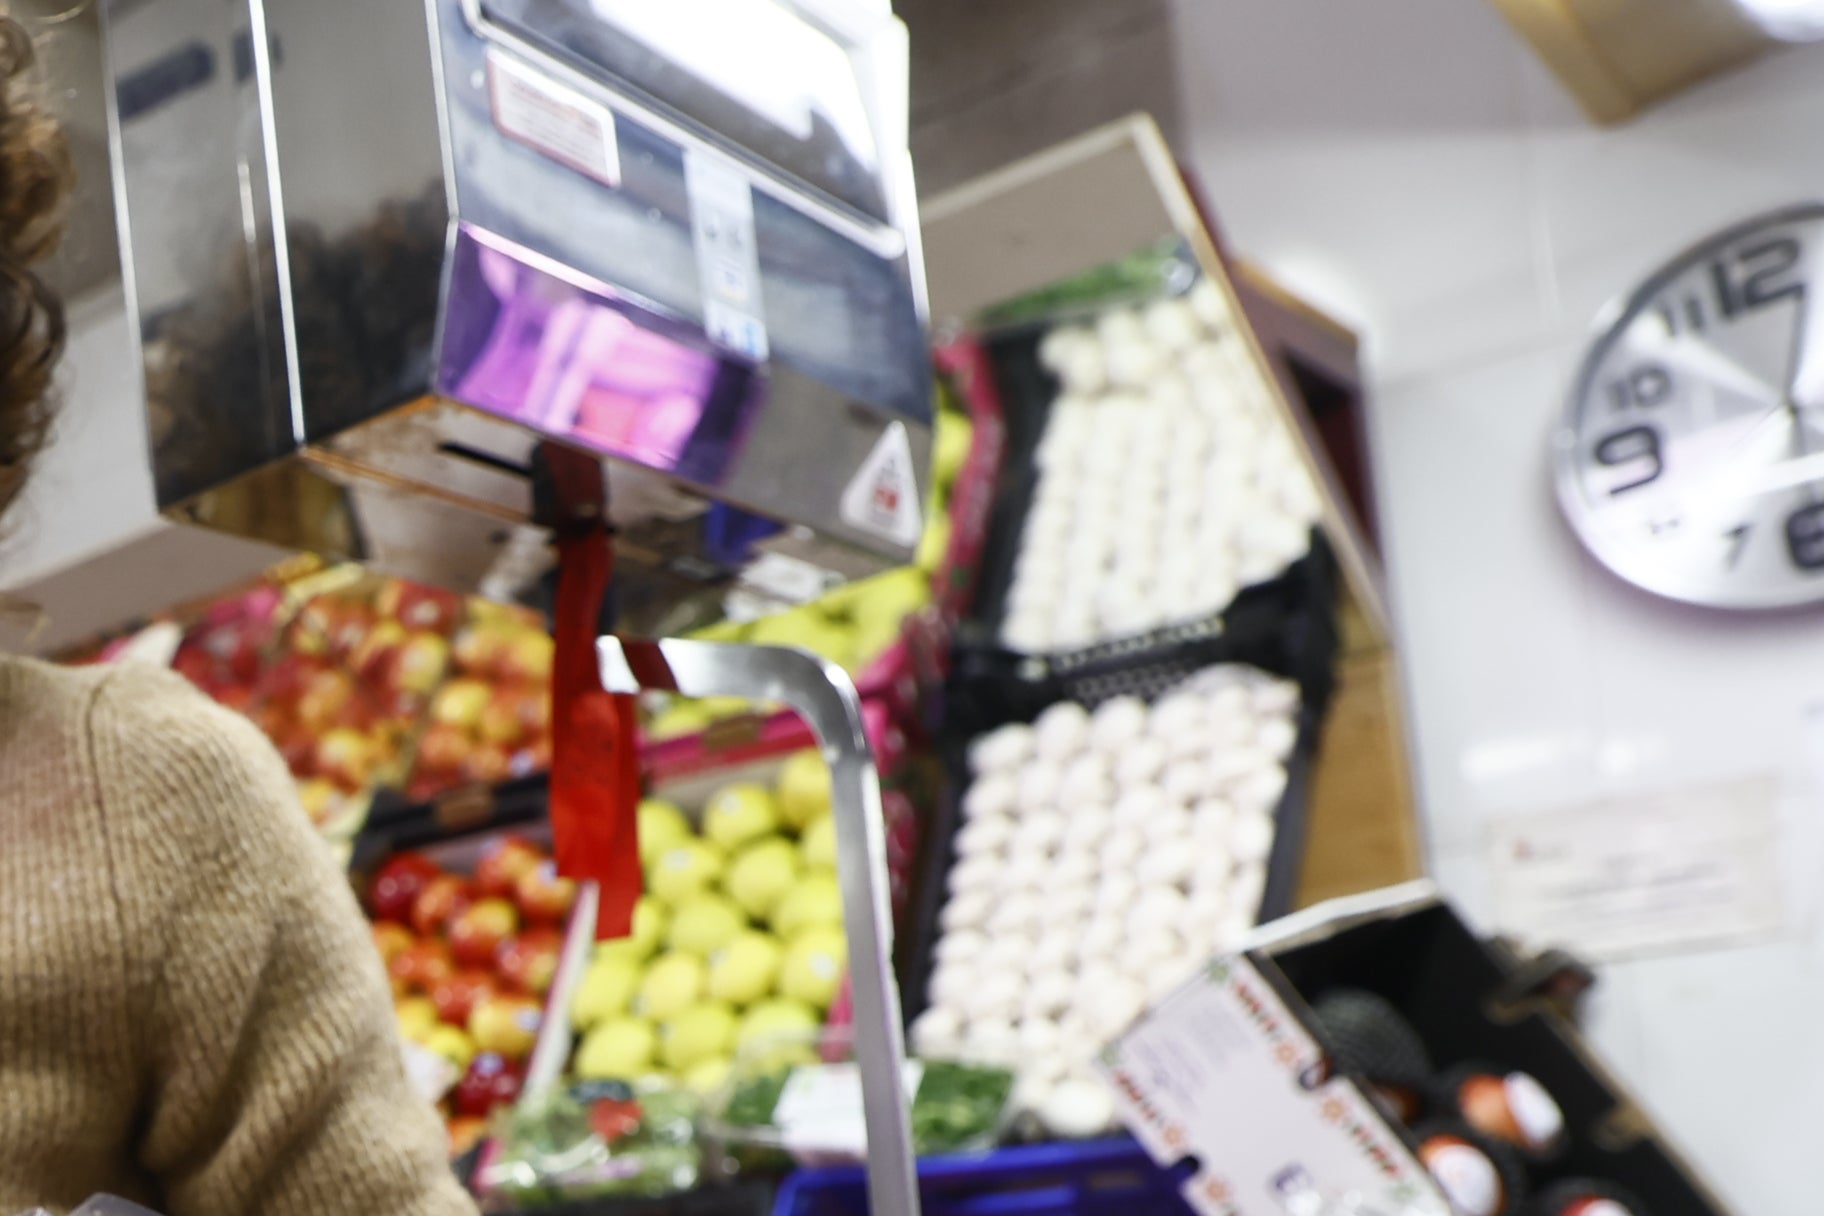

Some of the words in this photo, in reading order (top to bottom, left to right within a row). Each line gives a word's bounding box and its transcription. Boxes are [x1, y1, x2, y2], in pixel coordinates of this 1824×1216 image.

[1714, 237, 1804, 316] 12
[1607, 364, 1671, 412] 10
[1592, 423, 1664, 496] 9
